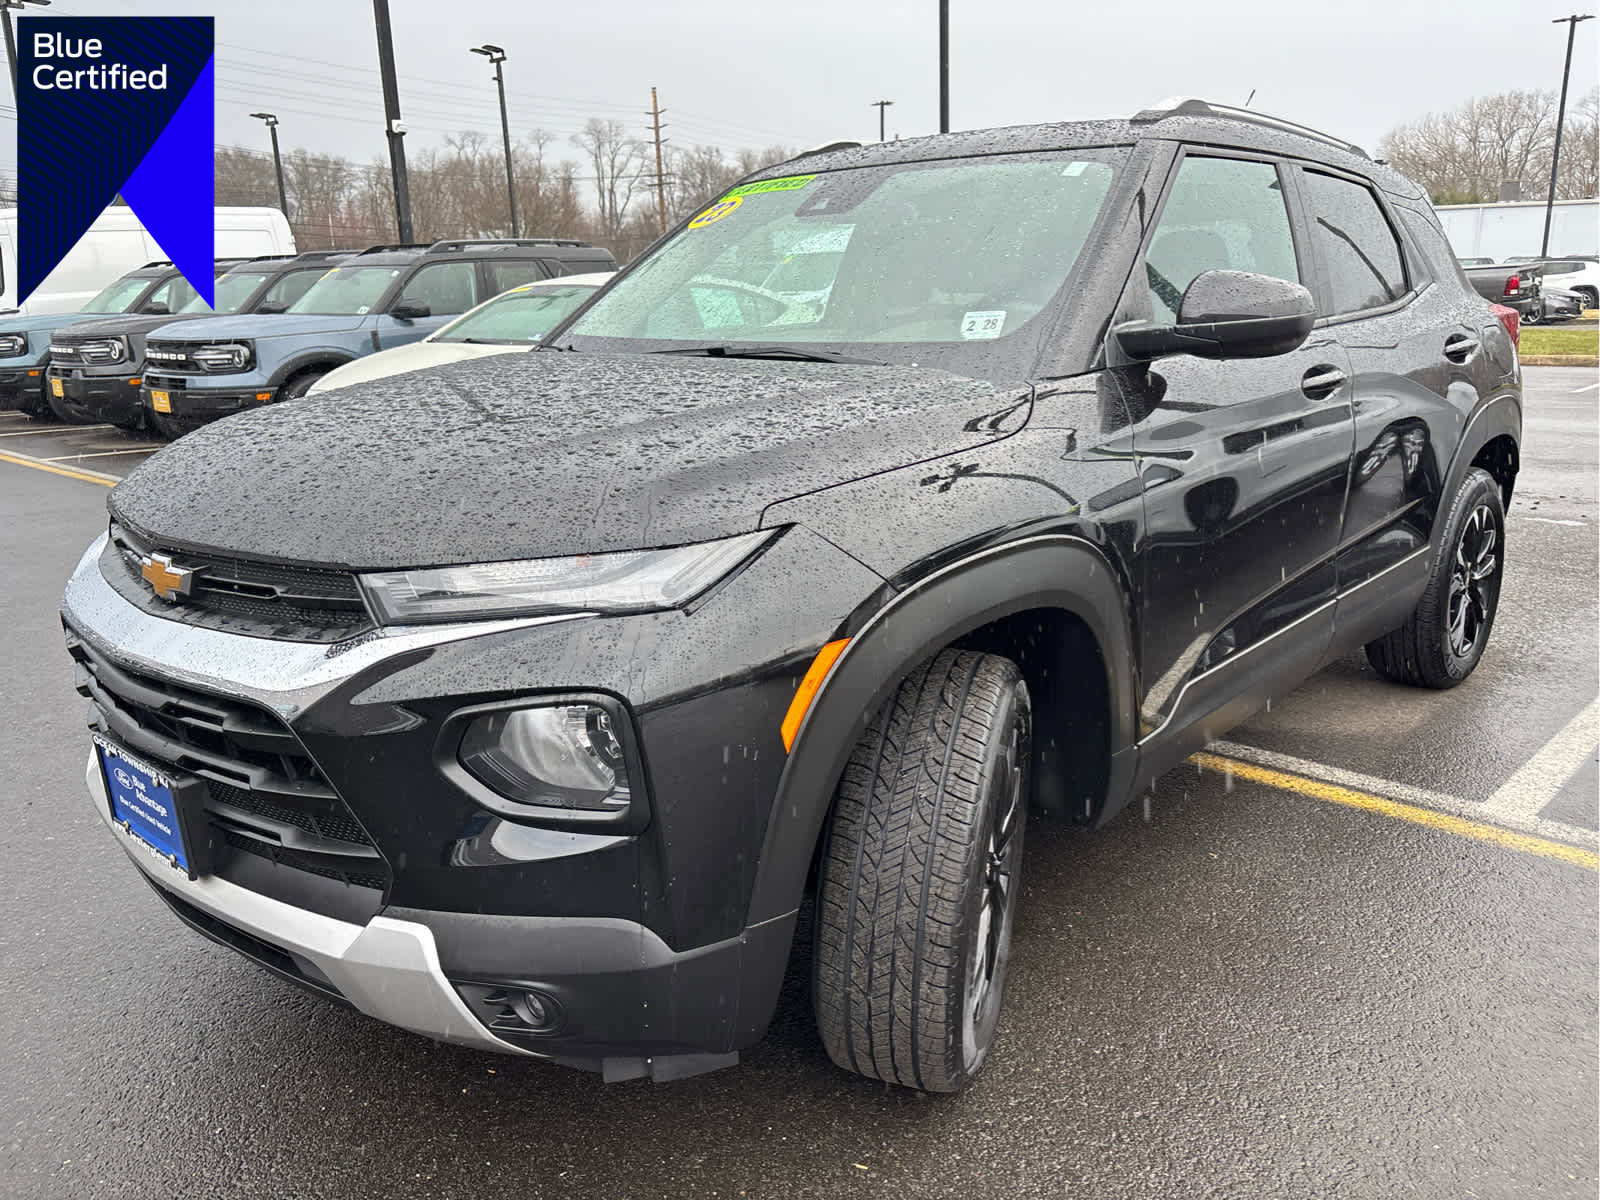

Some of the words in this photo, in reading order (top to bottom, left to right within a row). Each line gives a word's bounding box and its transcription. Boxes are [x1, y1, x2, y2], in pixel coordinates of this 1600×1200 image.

[966, 320, 976, 331] 2
[982, 318, 998, 330] 28
[131, 775, 146, 792] Blue
